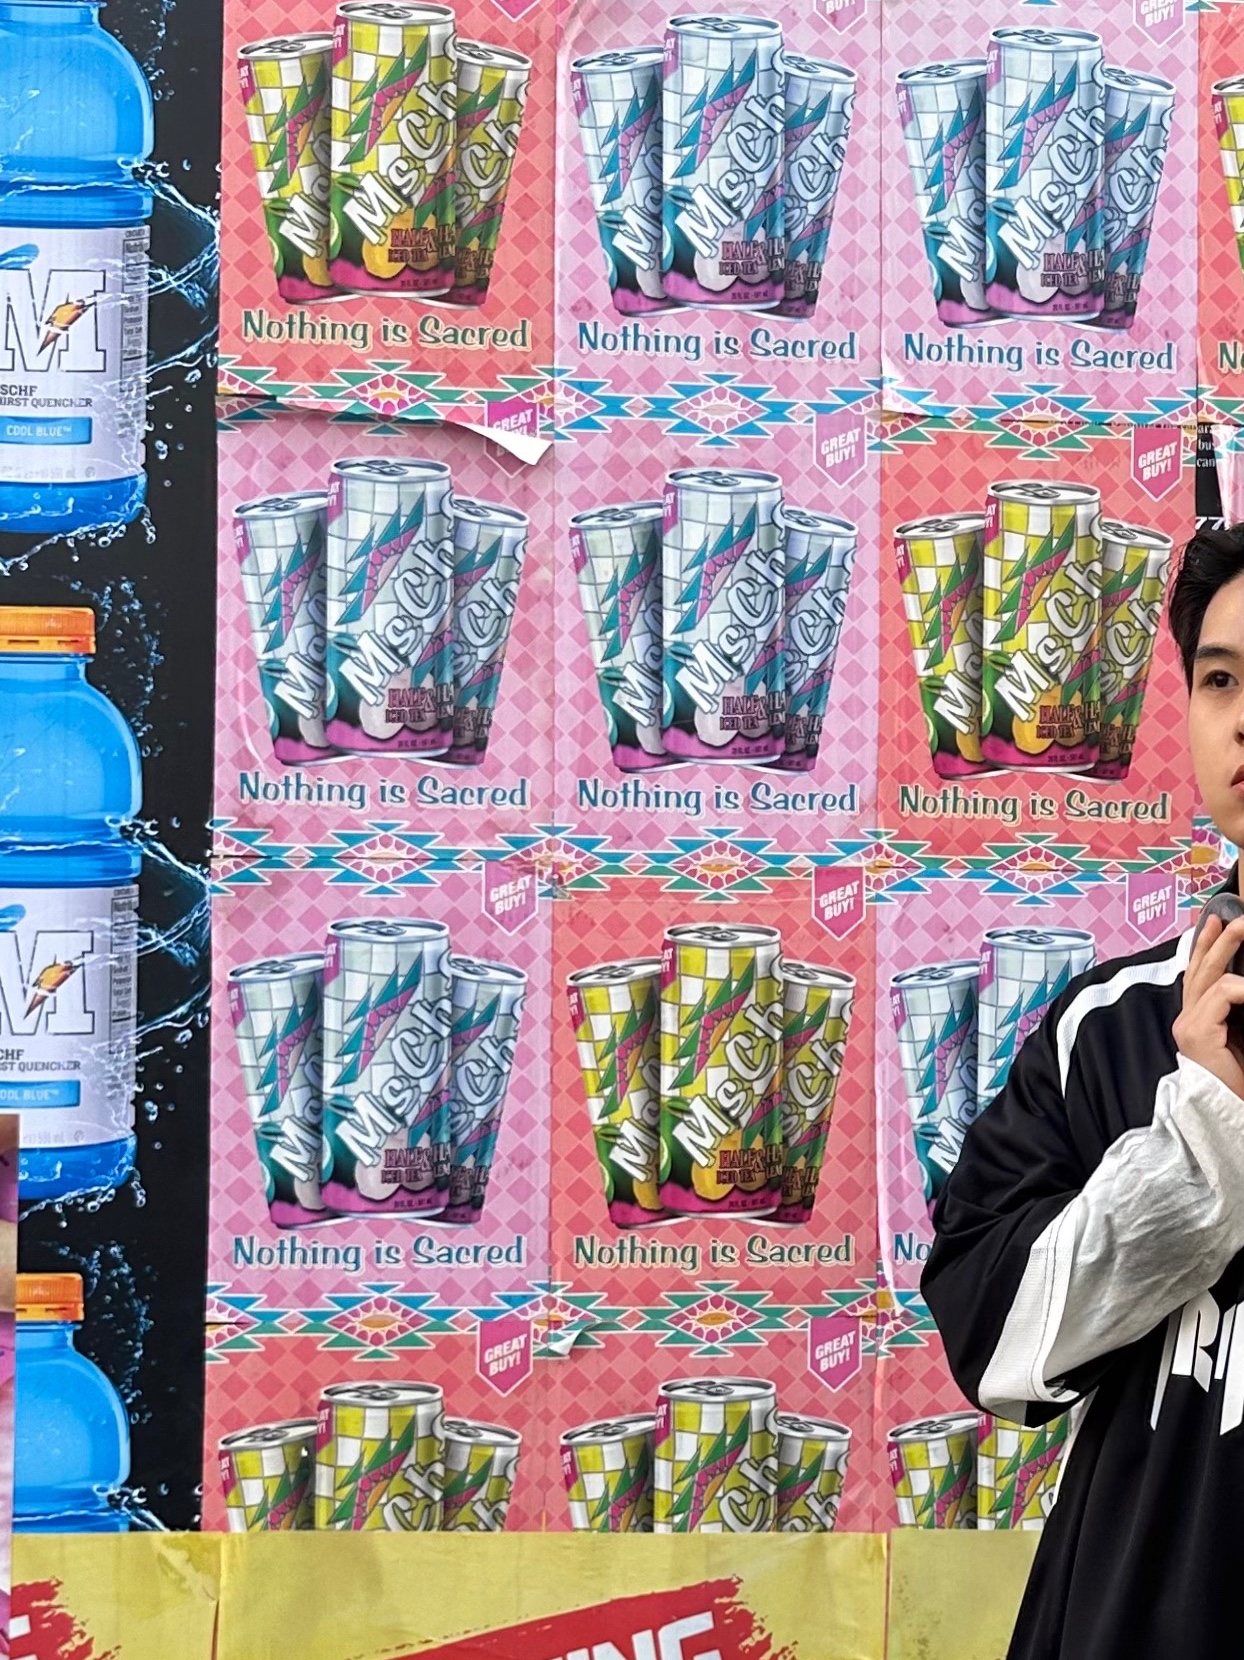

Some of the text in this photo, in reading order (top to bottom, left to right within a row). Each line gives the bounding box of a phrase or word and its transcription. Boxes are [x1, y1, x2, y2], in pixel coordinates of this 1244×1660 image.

[1145, 6, 1174, 27] BUY!
[243, 309, 528, 349] Nothing is Sacred
[577, 322, 856, 361] Nothing is Sacred
[904, 332, 1173, 372] Nothing is Sacred
[6, 425, 34, 436] COOL
[820, 428, 861, 456] GREAT
[826, 444, 856, 468] BUY!
[1138, 441, 1177, 469] GREAT
[1142, 458, 1172, 482] BUY!
[240, 771, 527, 810] Nothing is Sacred
[578, 778, 856, 816] Nothing is Sacred
[900, 785, 1168, 822] Nothing is Sacred
[489, 876, 531, 902] GREAT
[819, 881, 859, 908] GREAT
[1132, 885, 1172, 914] GREAT
[494, 893, 527, 915] BUY!
[824, 897, 855, 921] BUY!
[1137, 902, 1167, 926] BUY!
[234, 1234, 524, 1272] Nothing is Sacred
[575, 1234, 852, 1271] Nothing is Sacred
[484, 1333, 527, 1364] GREAT
[815, 1331, 856, 1361] GREAT
[819, 1347, 851, 1373] BUY!
[489, 1352, 521, 1377] BUY!
